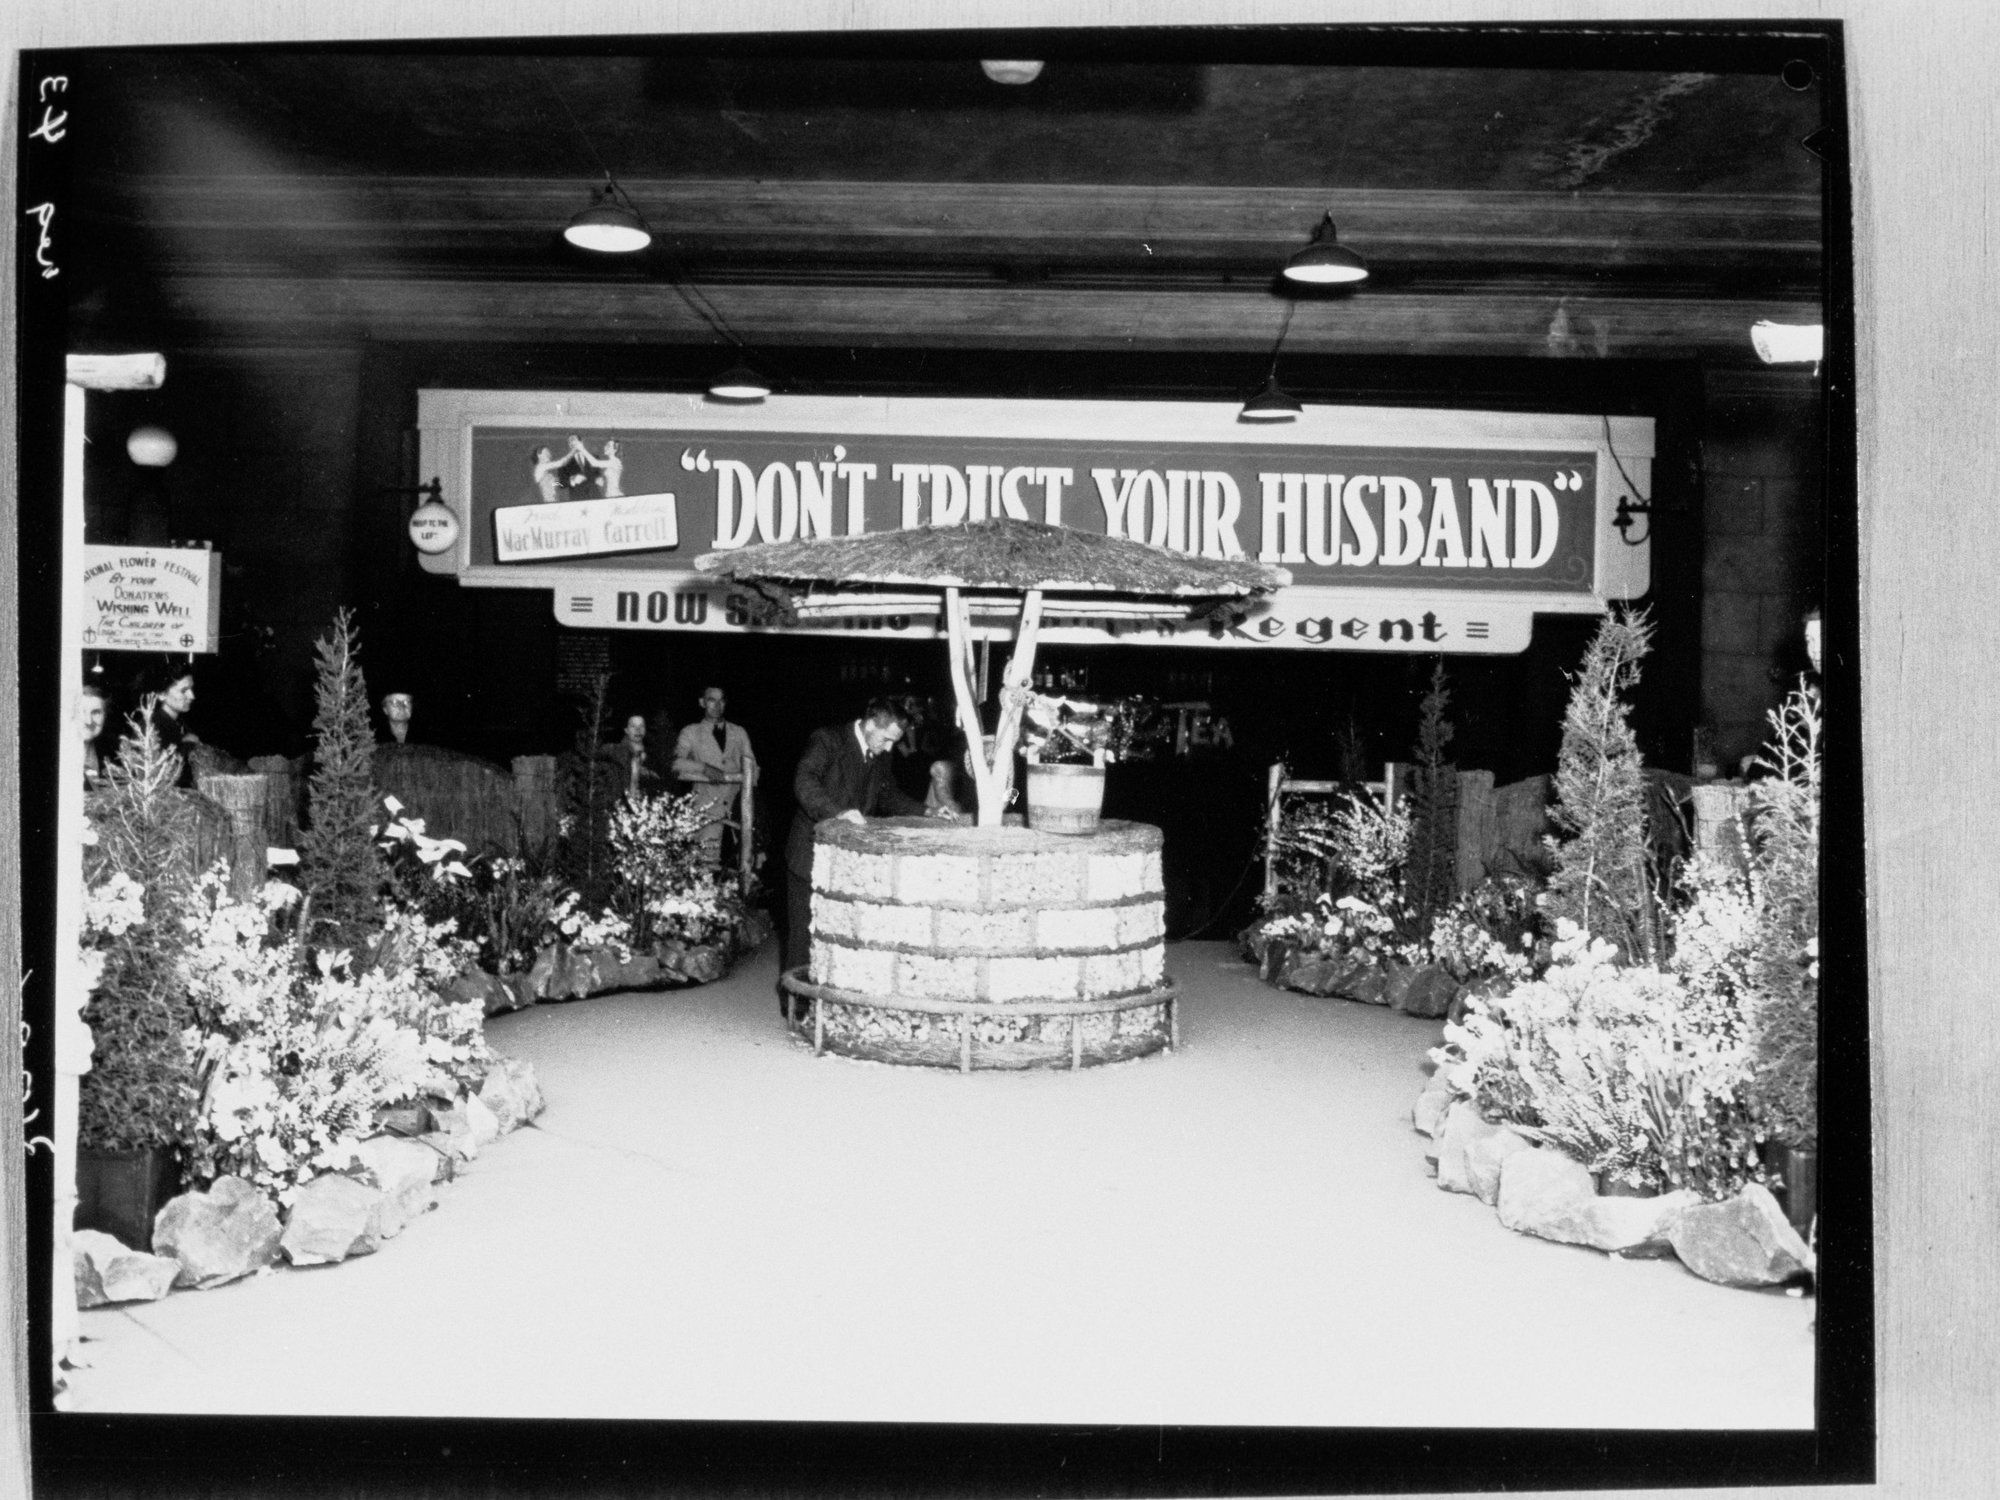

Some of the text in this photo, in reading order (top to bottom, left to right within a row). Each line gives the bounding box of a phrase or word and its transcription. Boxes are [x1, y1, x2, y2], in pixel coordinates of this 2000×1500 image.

[1091, 468, 1246, 561] YOUR
[502, 516, 668, 552] MacMurray Carroll
[120, 557, 156, 568] FLOWER
[164, 561, 201, 586] FESTIVAL
[616, 590, 708, 626] now
